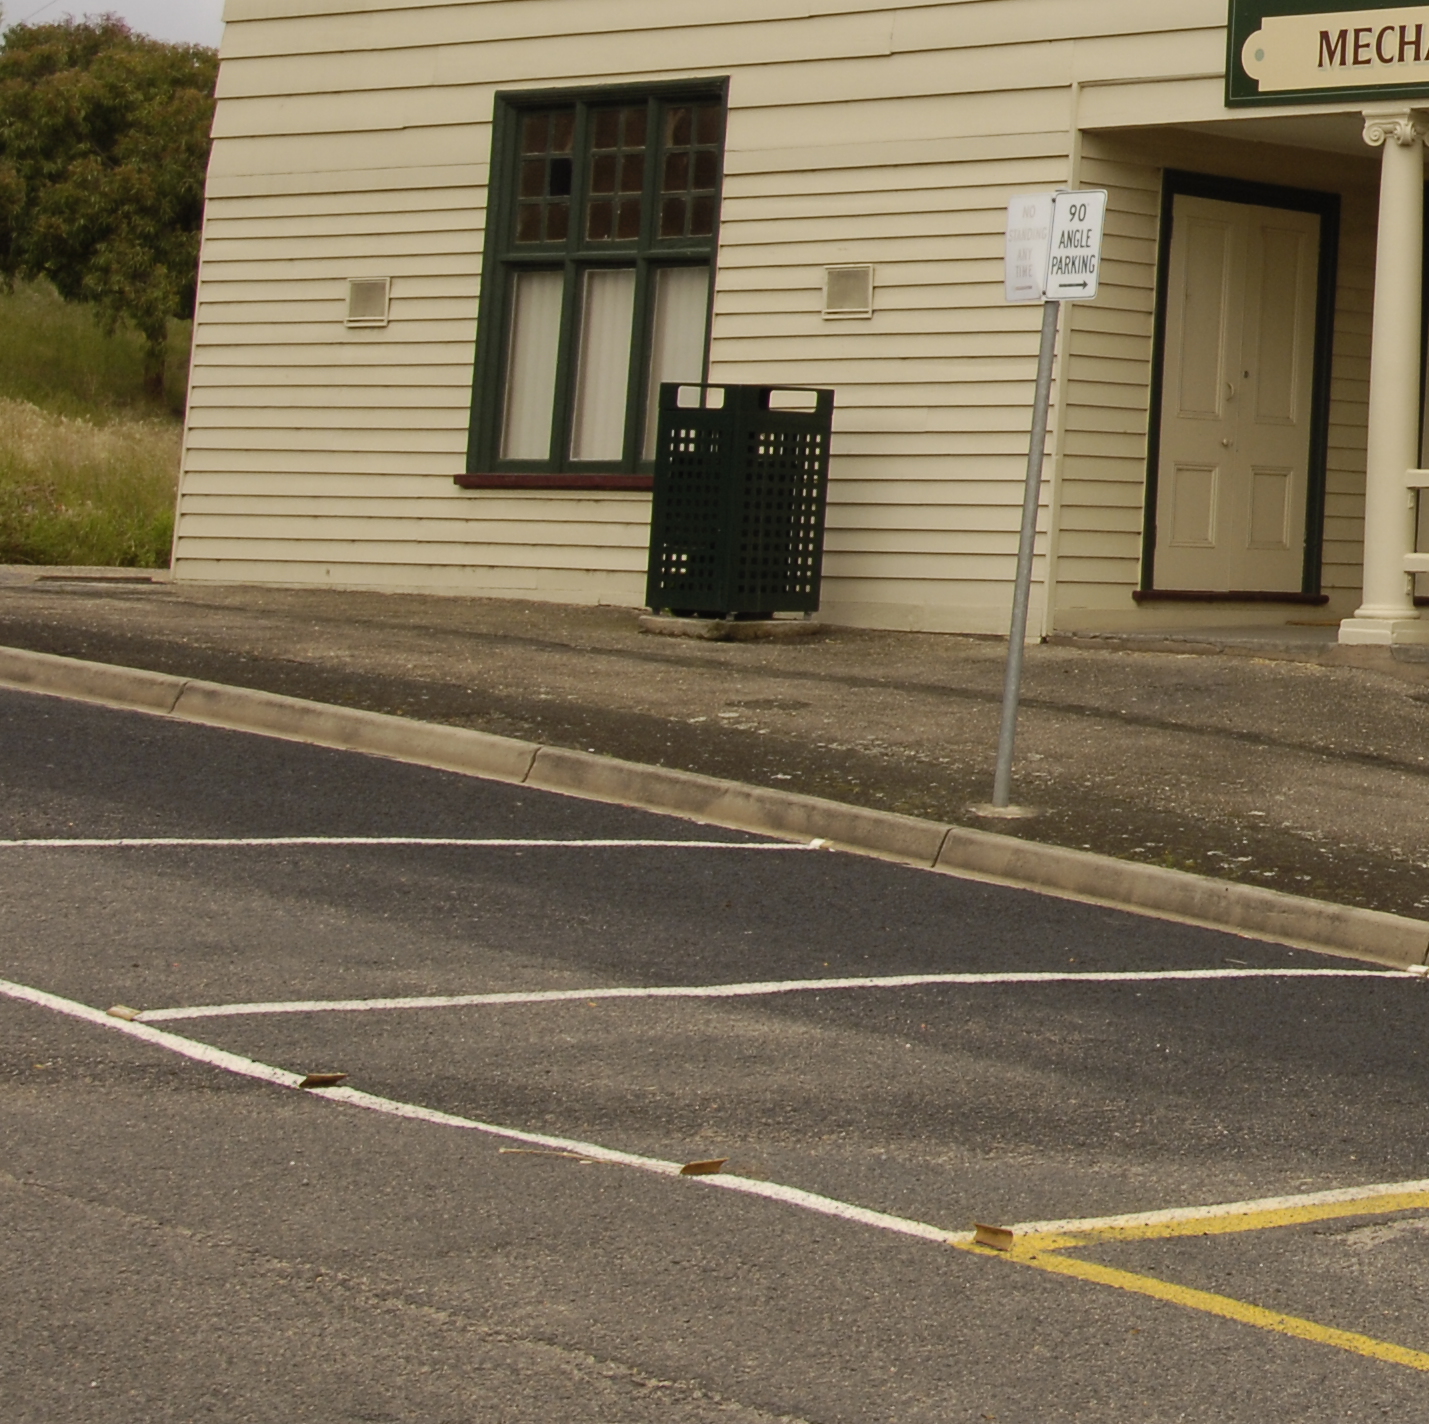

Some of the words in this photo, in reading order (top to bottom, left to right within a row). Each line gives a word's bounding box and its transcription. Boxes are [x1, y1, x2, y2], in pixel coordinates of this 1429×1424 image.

[1022, 204, 1036, 219] NO
[1008, 227, 1048, 243] STANDING
[1058, 228, 1092, 250] ANGLE
[1016, 247, 1033, 262] ANY
[1015, 263, 1033, 278] TIME
[1050, 254, 1096, 276] PARKING
